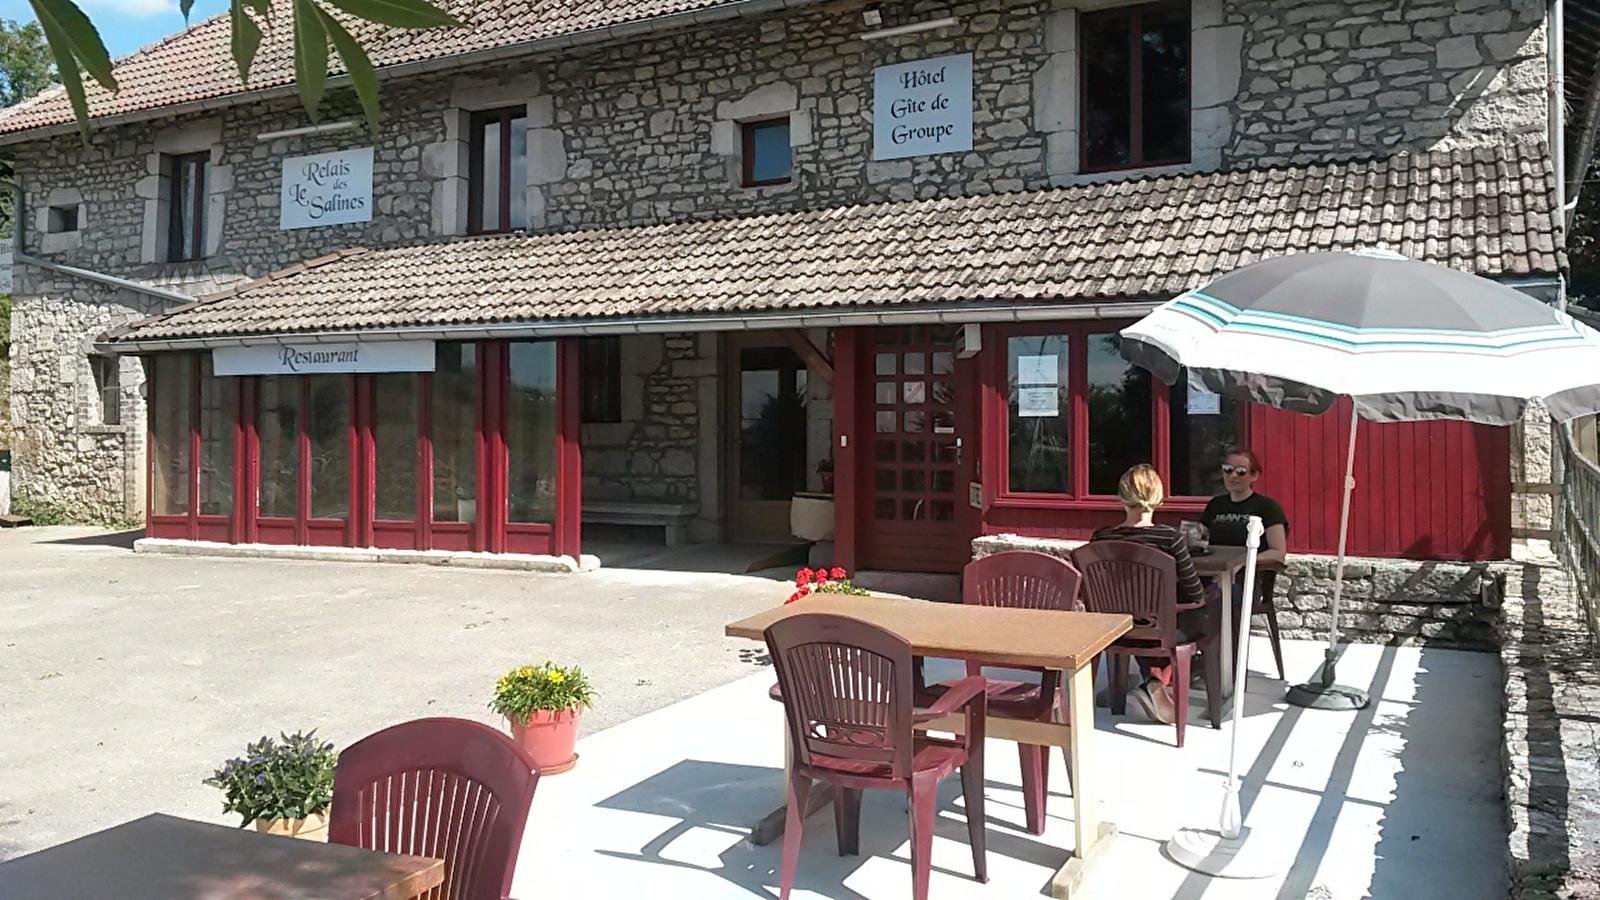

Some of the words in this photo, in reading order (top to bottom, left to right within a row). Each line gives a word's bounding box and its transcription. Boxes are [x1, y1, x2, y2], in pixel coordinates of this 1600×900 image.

[900, 66, 946, 89] Hôtel
[891, 98, 926, 118] Gîte
[931, 93, 949, 110] de
[892, 124, 954, 145] Groupe
[302, 159, 350, 187] Relais
[332, 179, 348, 190] des
[289, 183, 310, 207] Le
[309, 194, 364, 219] Salines
[278, 346, 358, 371] Restaurant
